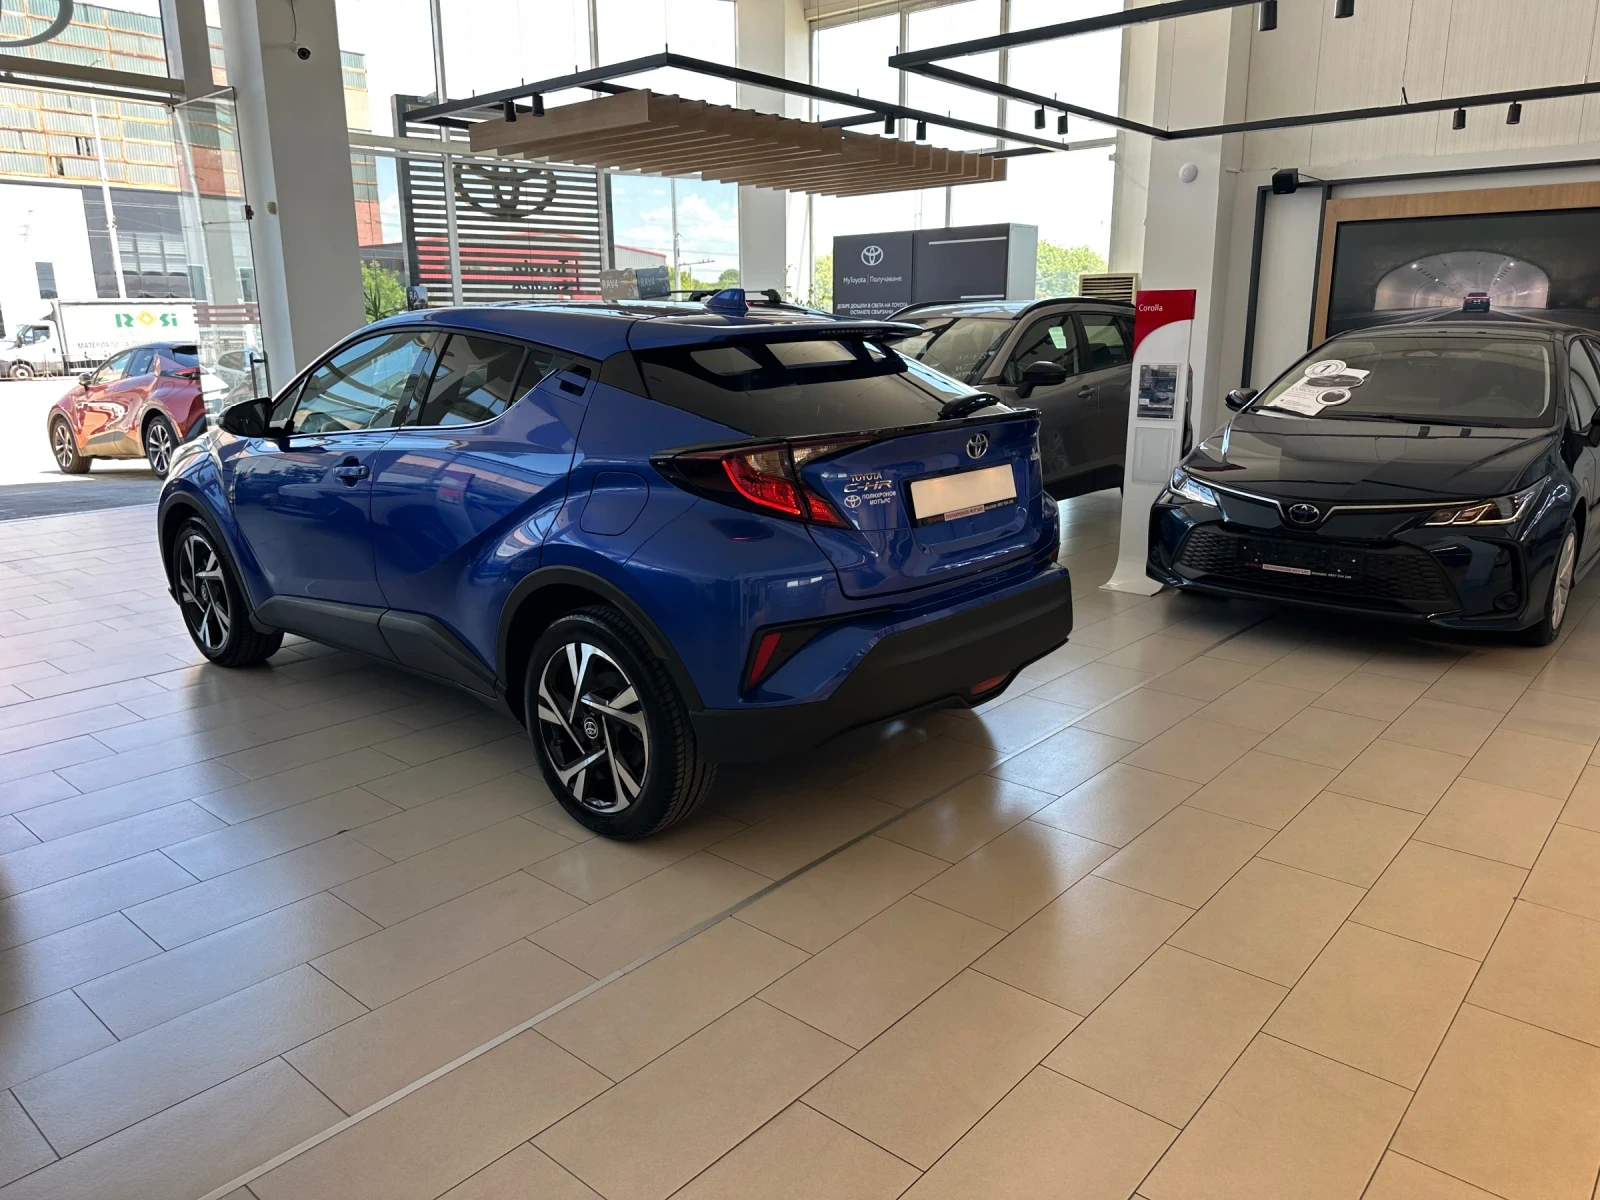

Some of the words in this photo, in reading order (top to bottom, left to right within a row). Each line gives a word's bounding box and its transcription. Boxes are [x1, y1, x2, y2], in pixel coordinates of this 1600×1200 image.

[602, 280, 618, 289] RAV4
[640, 276, 654, 287] RAV4
[843, 276, 866, 284] MyToyota
[870, 276, 902, 284] Получаване
[1138, 303, 1163, 312] Corolla
[850, 472, 882, 482] TOYOTA
[844, 480, 892, 492] C-HR
[862, 491, 896, 500] ПОЛИХРОНОВ
[869, 498, 891, 506] МОТЪРС
